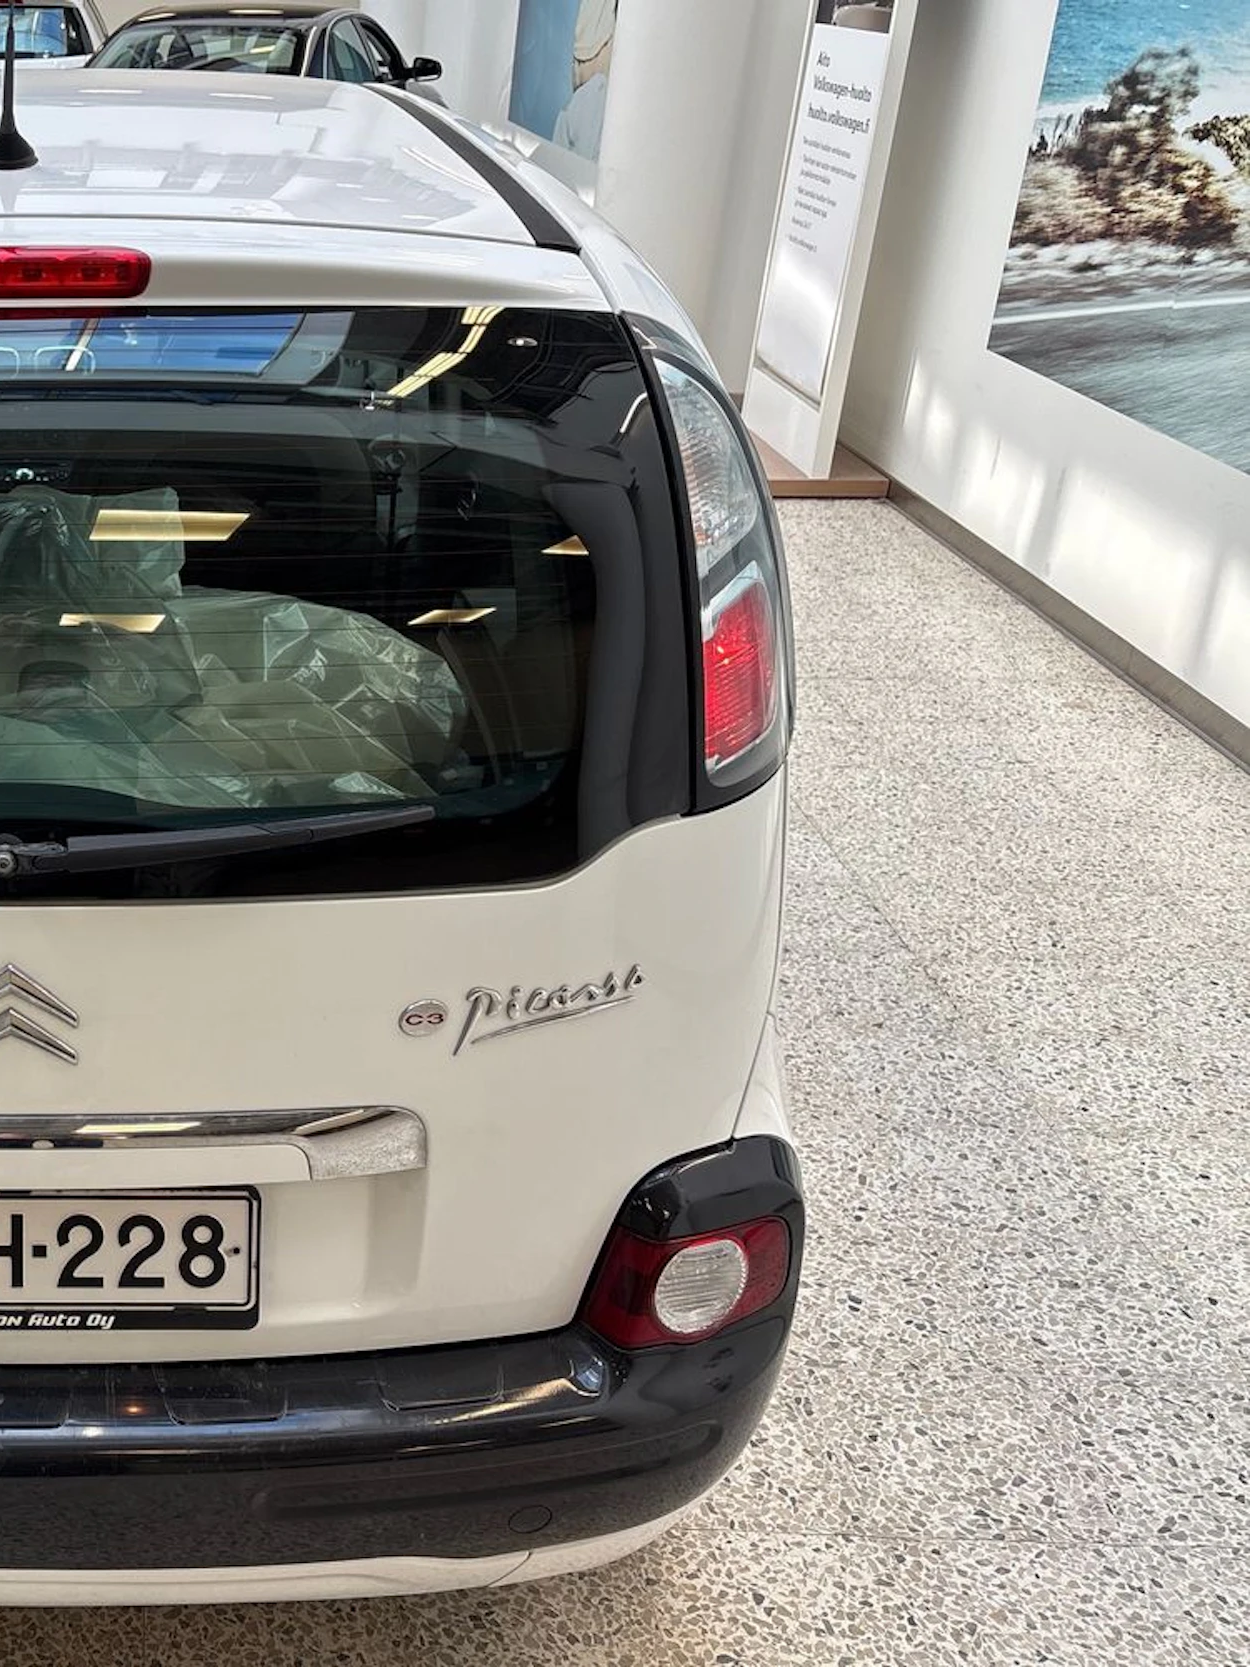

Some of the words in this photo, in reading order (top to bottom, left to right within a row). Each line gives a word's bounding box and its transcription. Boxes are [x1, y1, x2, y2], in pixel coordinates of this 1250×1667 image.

[405, 1013, 444, 1026] C3
[27, 1312, 81, 1327] Auto
[86, 1312, 115, 1330] Oy
